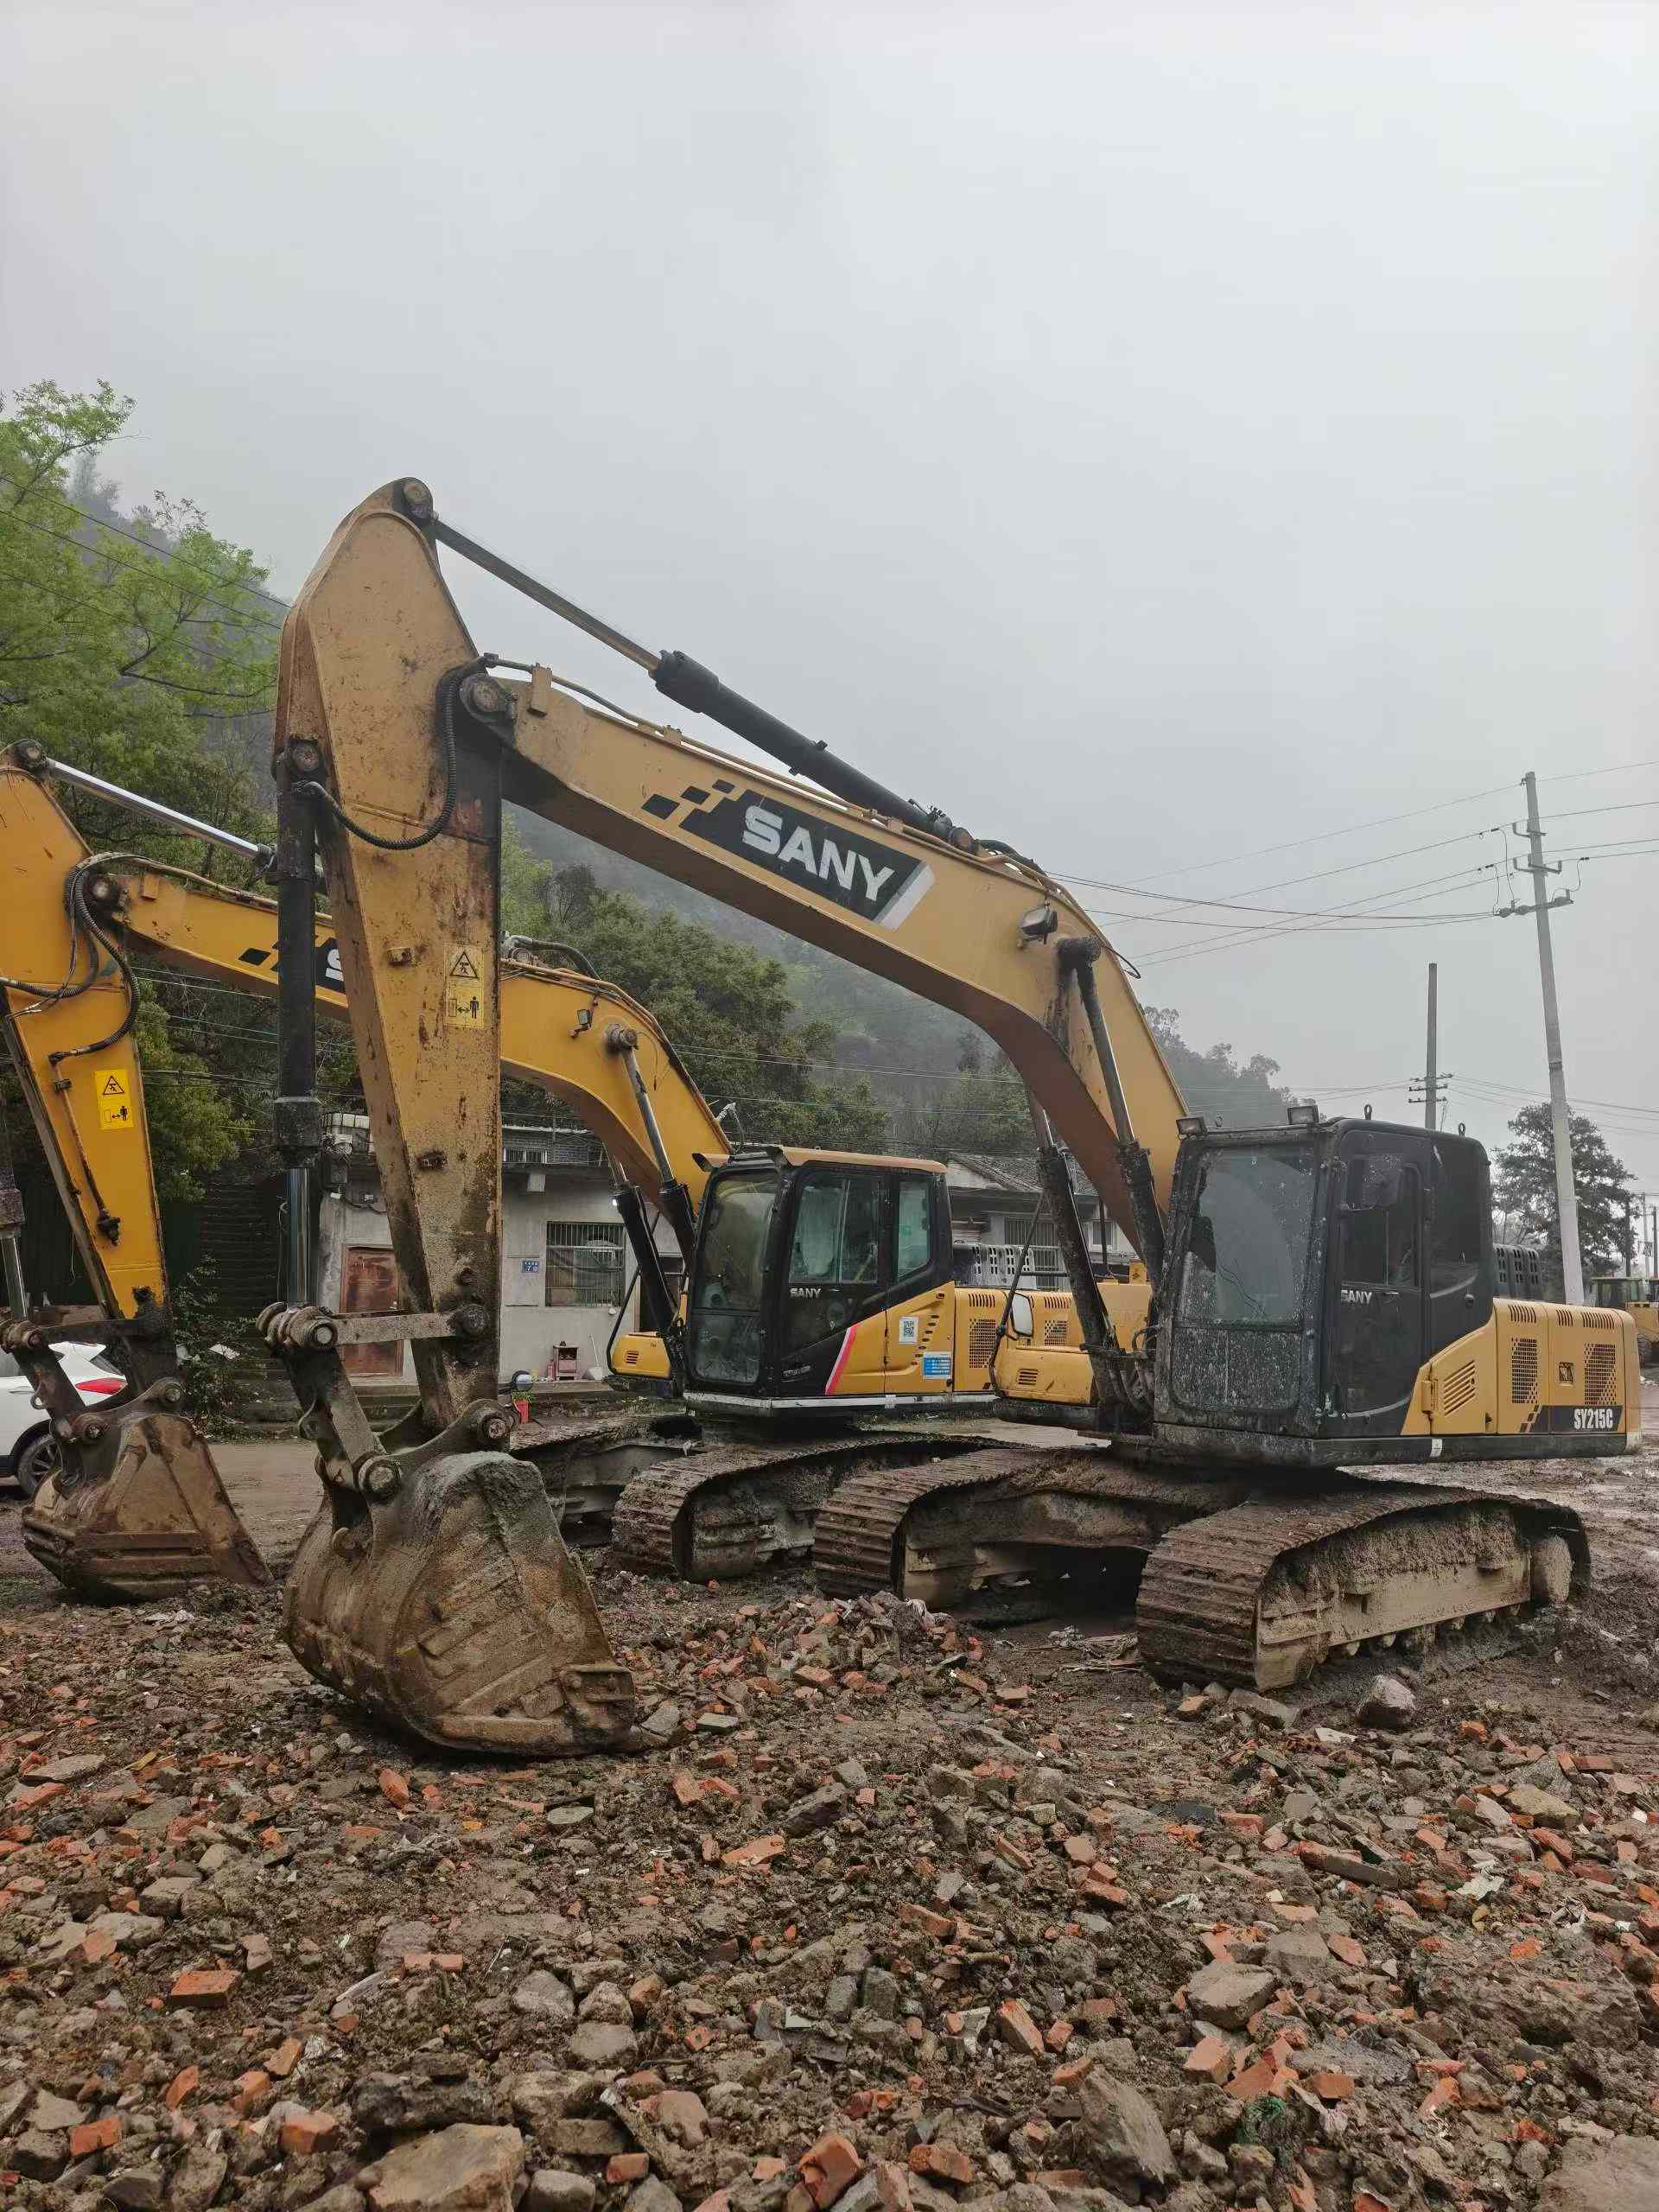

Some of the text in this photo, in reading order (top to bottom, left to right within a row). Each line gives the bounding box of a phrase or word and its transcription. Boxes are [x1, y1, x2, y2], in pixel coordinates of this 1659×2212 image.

[741, 804, 895, 902] SANY
[790, 1287, 822, 1299] SANY
[1341, 1289, 1372, 1304] SANY
[1573, 1408, 1613, 1430] SY215C
